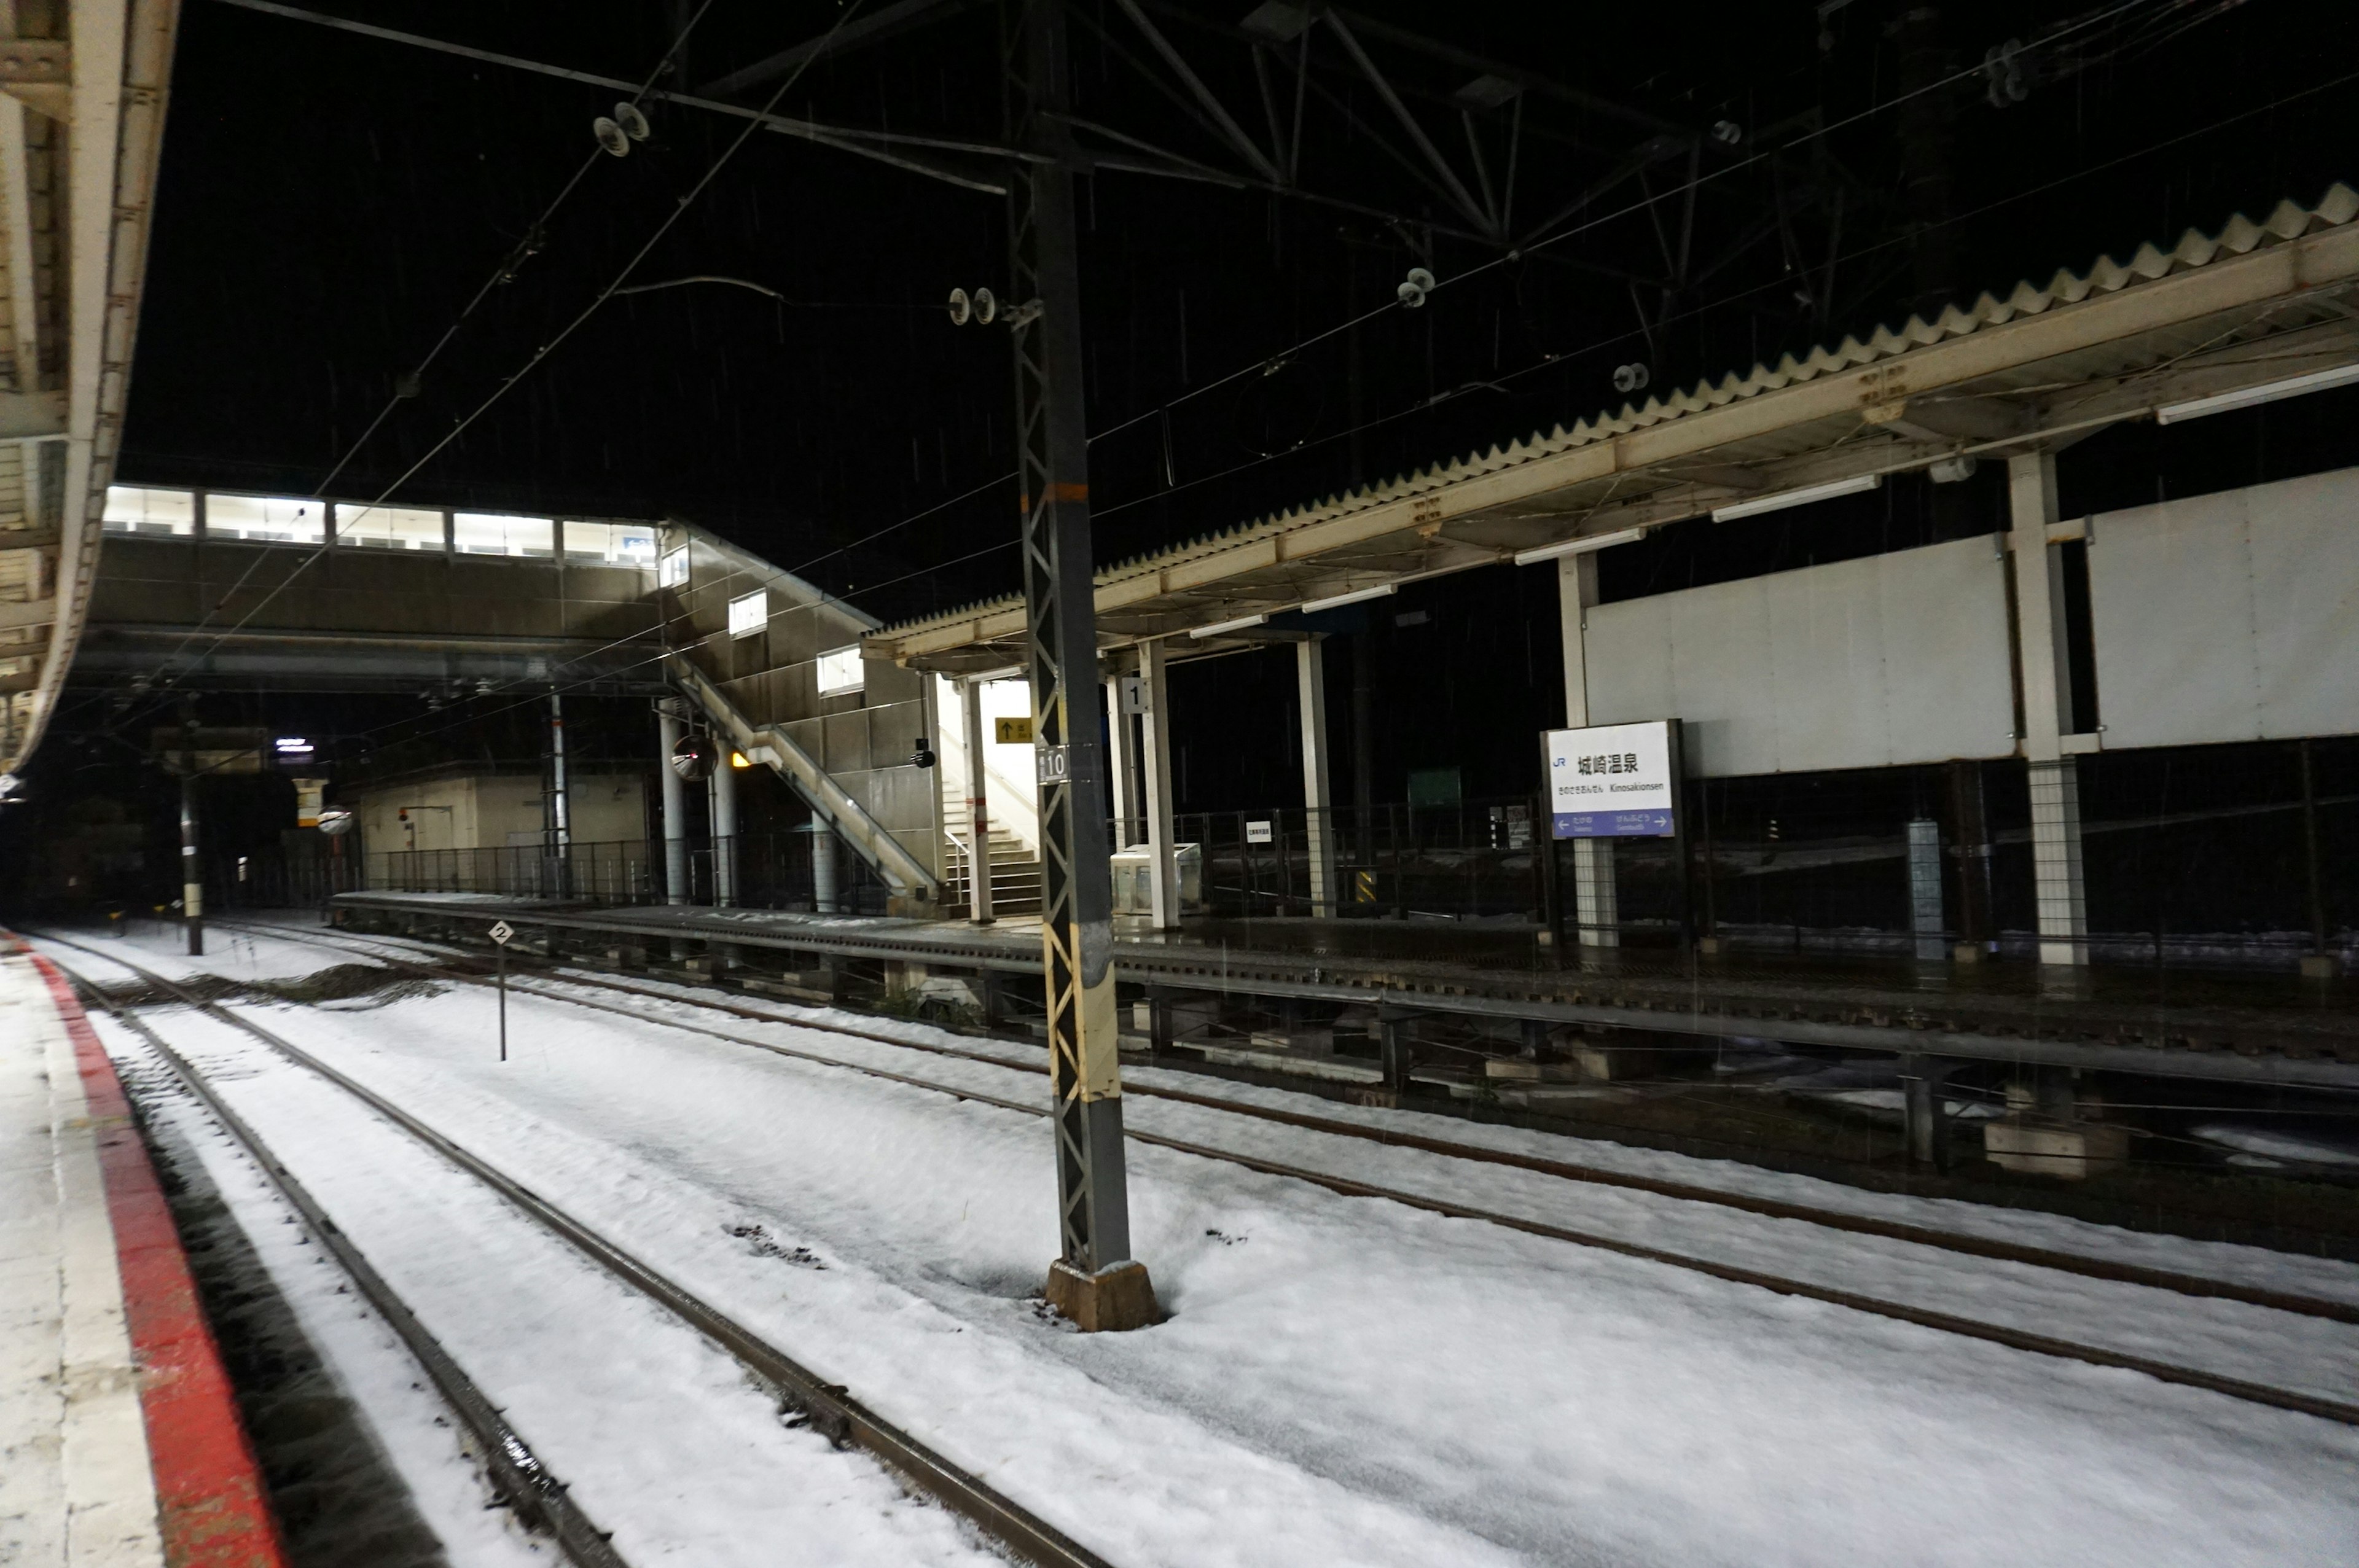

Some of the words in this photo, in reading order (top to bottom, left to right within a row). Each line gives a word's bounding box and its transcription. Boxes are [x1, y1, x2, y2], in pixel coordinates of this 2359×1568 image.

[1130, 686, 1138, 704] 1
[1047, 754, 1065, 775] 10
[1553, 758, 1566, 767] JR
[1578, 753, 1638, 776] 城崎温泉
[1610, 782, 1664, 792] Kinosakionsen
[495, 927, 507, 938] 2
